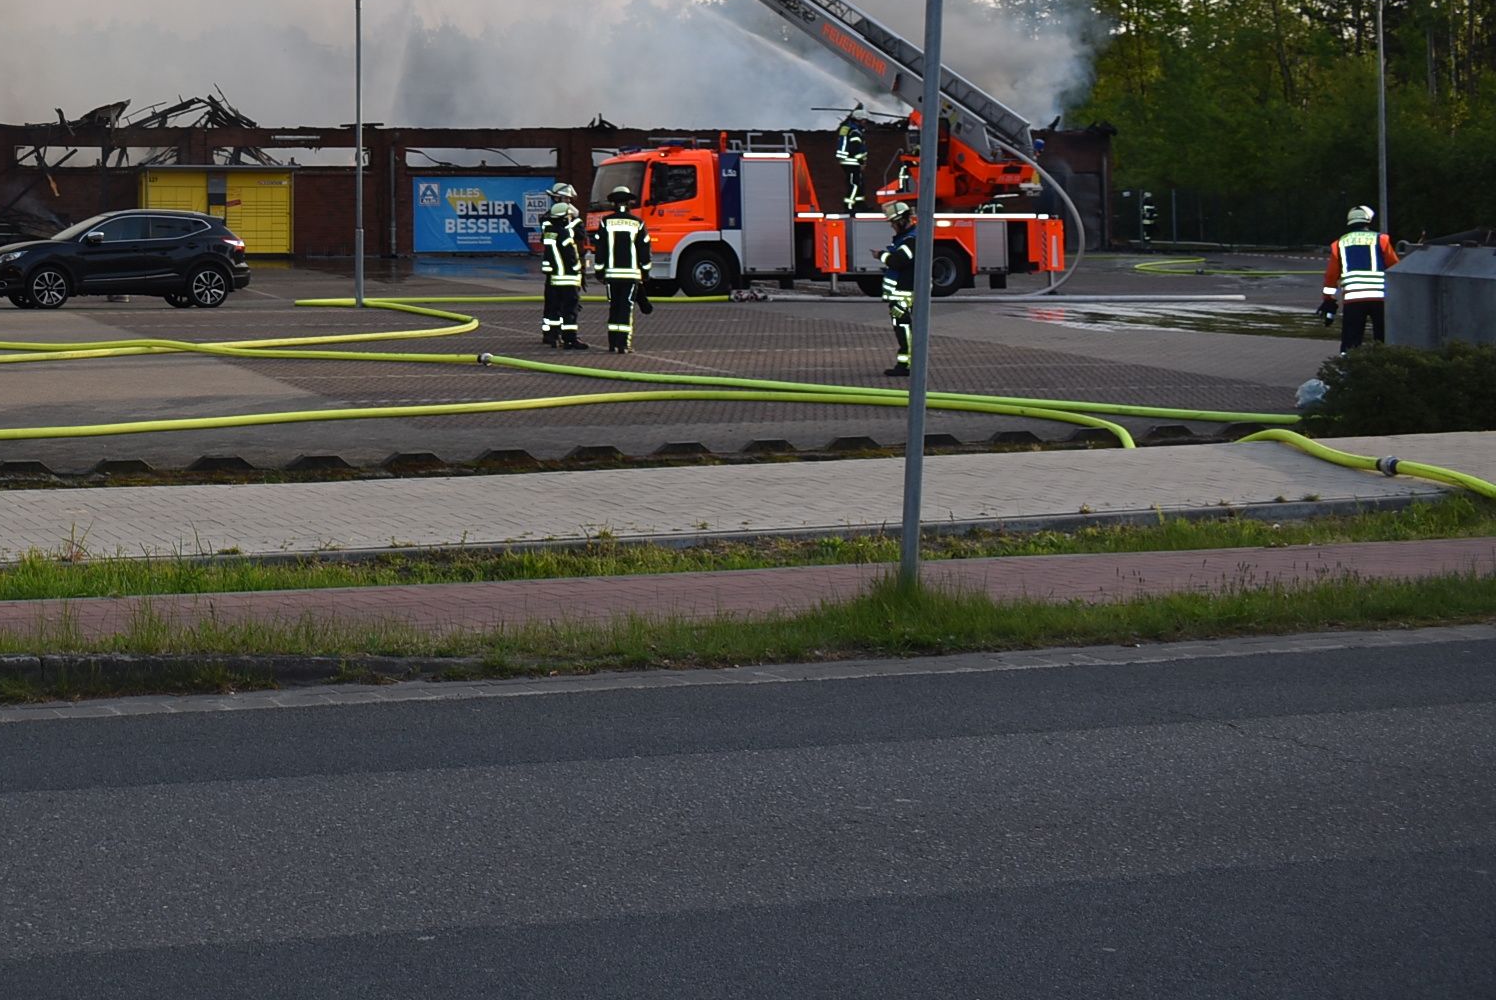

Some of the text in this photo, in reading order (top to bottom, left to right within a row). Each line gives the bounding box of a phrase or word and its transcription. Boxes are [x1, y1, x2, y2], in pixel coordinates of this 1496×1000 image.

[821, 23, 887, 77] FEUERWEHR
[445, 188, 481, 198] ALLES
[456, 201, 515, 216] BLEIBT
[527, 200, 547, 208] ALDI
[445, 218, 515, 234] BESSER.
